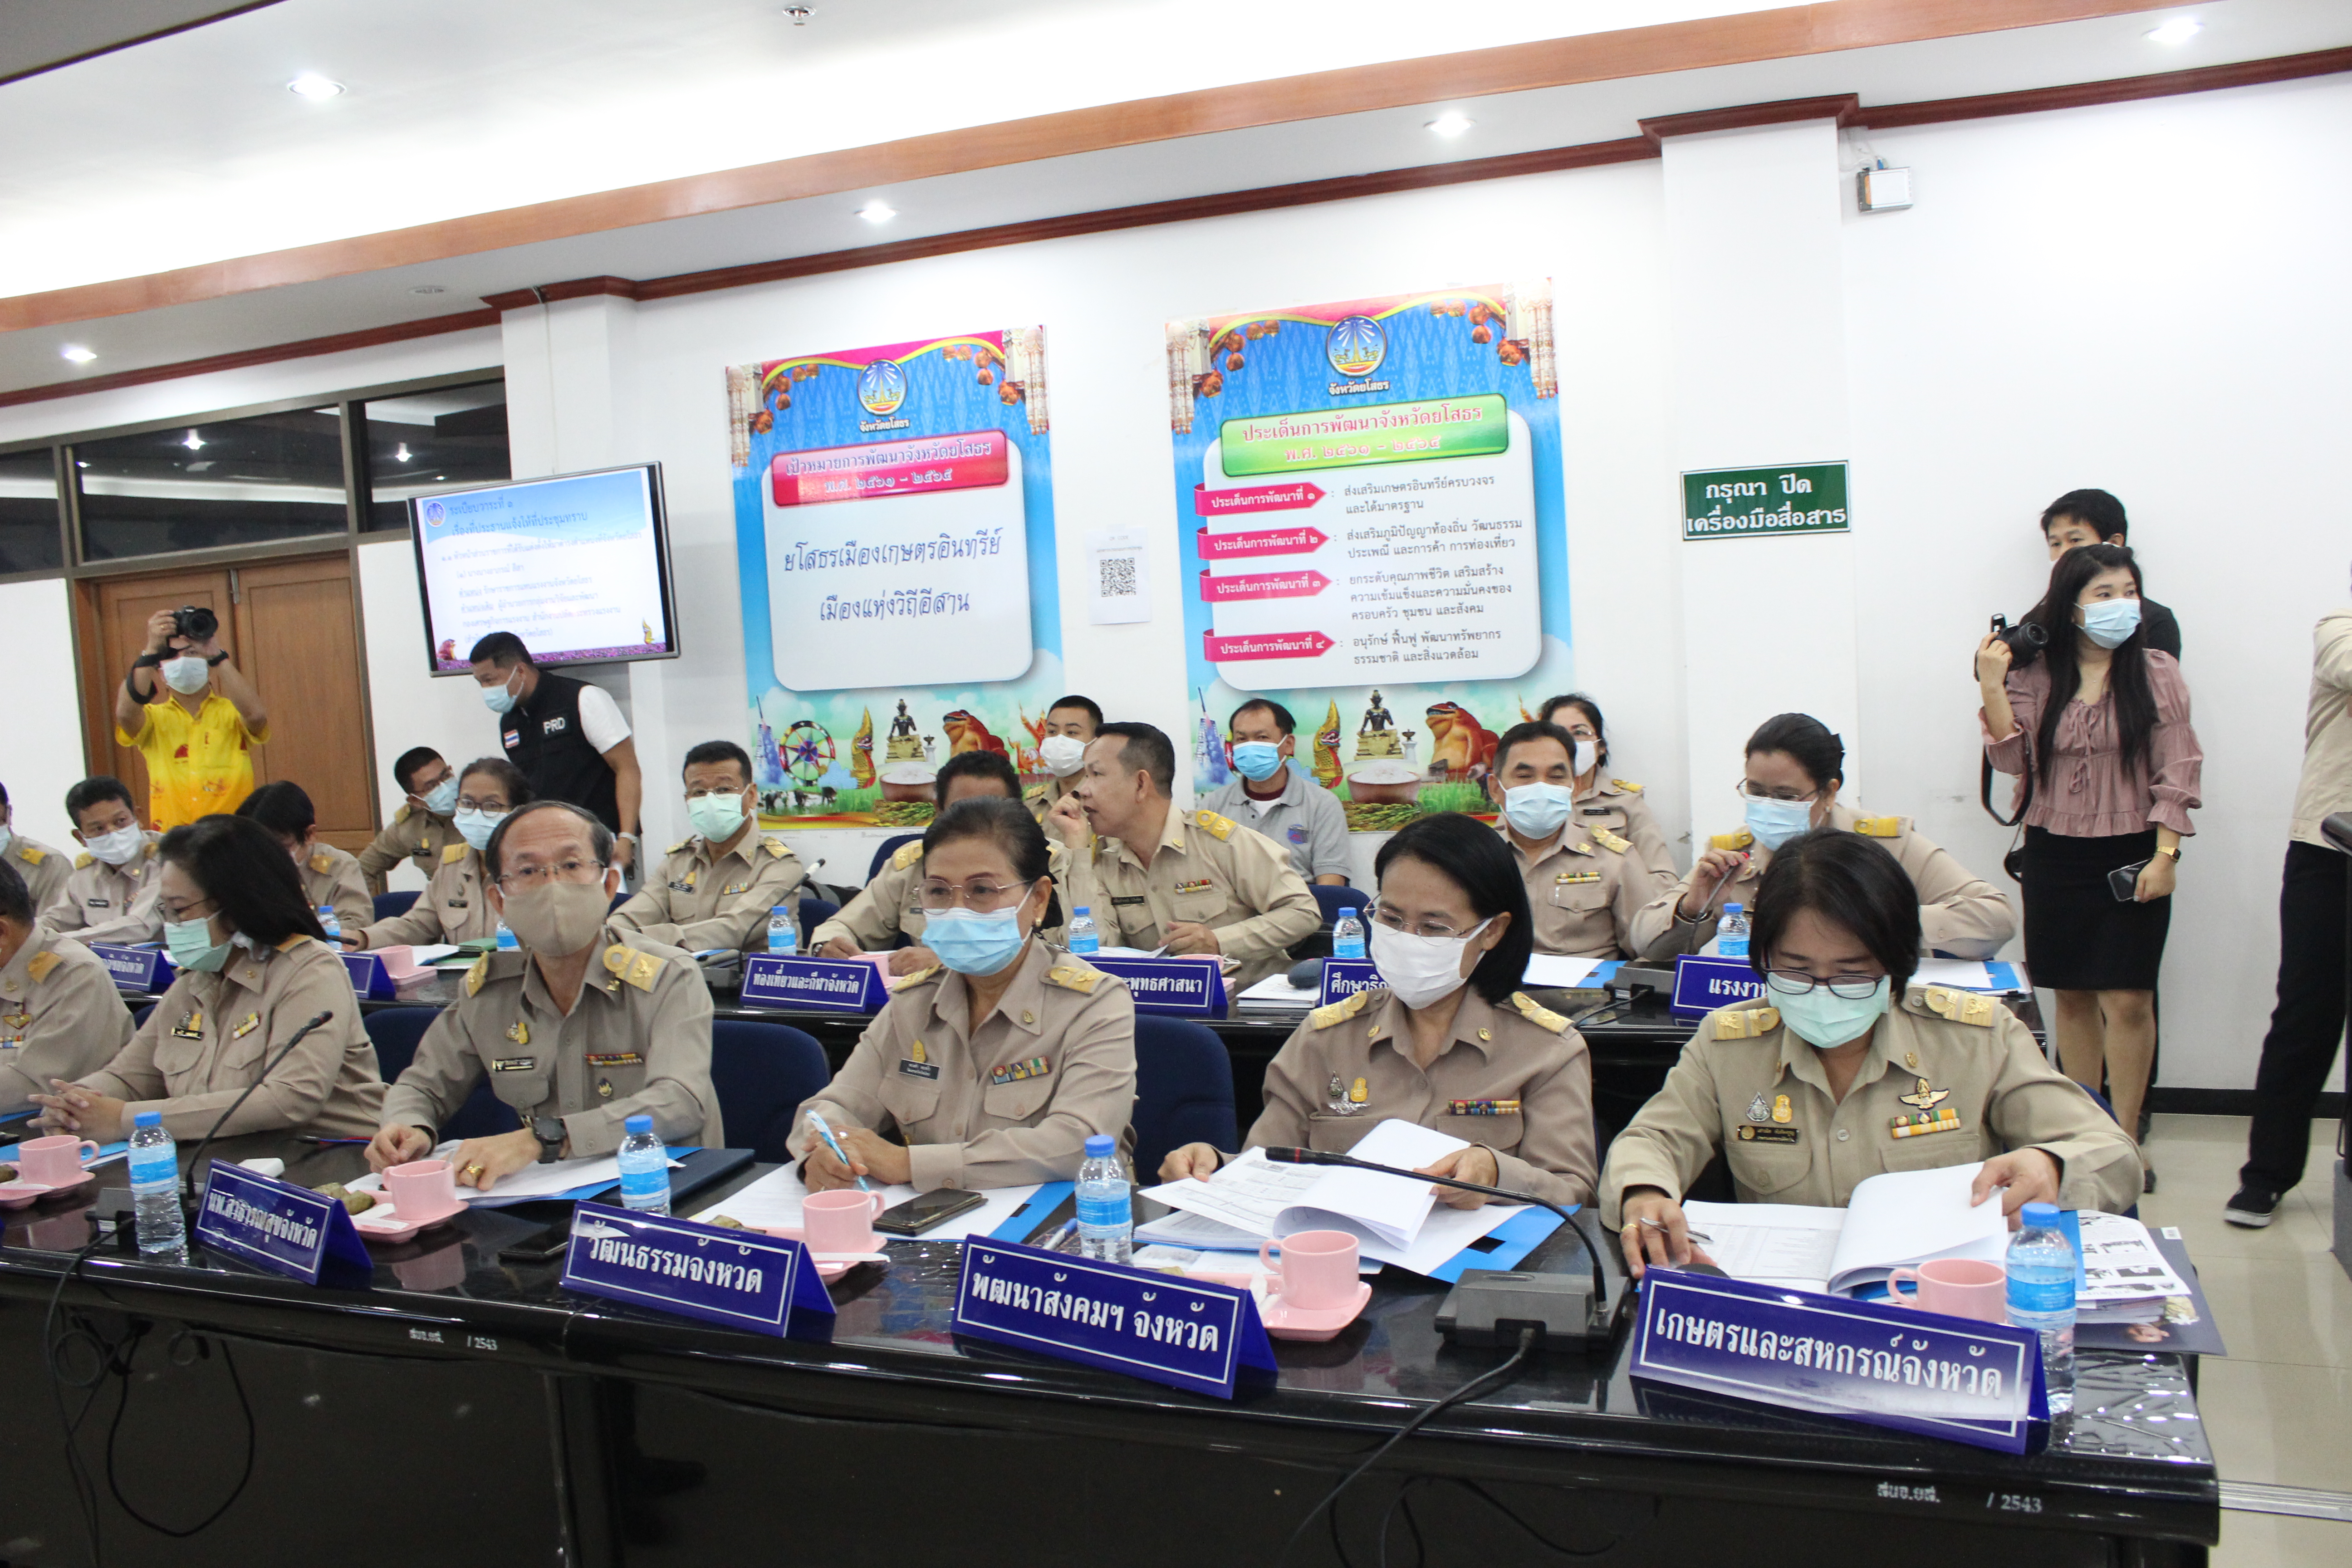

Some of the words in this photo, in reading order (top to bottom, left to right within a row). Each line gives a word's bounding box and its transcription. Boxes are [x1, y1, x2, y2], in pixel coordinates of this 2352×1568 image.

[1328, 379, 1390, 396] จังหวัดยโสธร
[860, 417, 910, 433] จังหวัดยโสธร
[1243, 403, 1482, 442] ประเด็นการพัฒนาจังหวัดยโสธร
[786, 438, 991, 476] เป้าหมายการพัฒนาจังหวัดยโสธร
[1285, 446, 1316, 461] พ.ศ.
[825, 477, 850, 493] พ.ศ.
[1211, 485, 1303, 508] ประเด็นการพัฒนาที่
[1344, 475, 1494, 496] ส่งเสริมเกษตรอินทรีย์ครบวงจร
[1706, 481, 1768, 504] กรุณา
[1779, 473, 1813, 494] ปิด
[1346, 499, 1424, 514] และได้มาตรฐาน
[1687, 501, 1847, 532] เครื่องมือสื่อสาร
[1214, 529, 1306, 551] ประเด็นการพัฒนาที่
[1309, 535, 1318, 544] ๒
[1347, 518, 1467, 542] ส่งเสริมภูมิปัญญาท้องถิ่น
[1472, 518, 1523, 531] วัฒนธรรม
[1348, 544, 1389, 559] ประเพณี
[1393, 540, 1446, 556] และการค้า
[1450, 532, 1515, 551] การท่องเที่ยว
[784, 527, 1004, 572] ยโสธรเมืองเกษตรอินทรีย์
[1217, 573, 1308, 594] ประเด็นการพัฒนาที่
[1349, 568, 1450, 586] ยกระดับคุณภาพชีวิต
[1454, 563, 1504, 578] เสริมสร้าง
[1351, 580, 1512, 603] ความเข้มแข็งและความมั่นคงของ
[820, 588, 970, 621] เมืองแห่งวิถีอีสาน
[1352, 607, 1398, 620] ครอบครัว
[1402, 607, 1432, 621] ชุมชน
[1436, 602, 1484, 616] และสังคม
[1220, 634, 1312, 654] ประเด็นการพัฒนาที่
[1353, 633, 1388, 650] อนุรักษ์
[1392, 629, 1417, 647] ฟื้นฟู
[1421, 629, 1501, 644] พัฒนาทรัพยากร
[1354, 651, 1399, 665] ธรรมชาติ
[1403, 646, 1479, 662] และสิ่งแวดล้อม
[543, 717, 566, 735] PRD
[753, 964, 860, 994] ท่องเที่ยวและกีฬาจังหวัด
[1121, 977, 1202, 997] ะพุทธศาสนา
[588, 1220, 763, 1294] วัฒนธรรมจังหวัด
[971, 1254, 1124, 1332] พัฒนาสังคมฯ
[1134, 1291, 1219, 1352] จังหวัด
[1656, 1307, 2002, 1399] เกษตรและสหกรณ์จังหวัด
[2000, 1494, 2042, 1513] 2543
